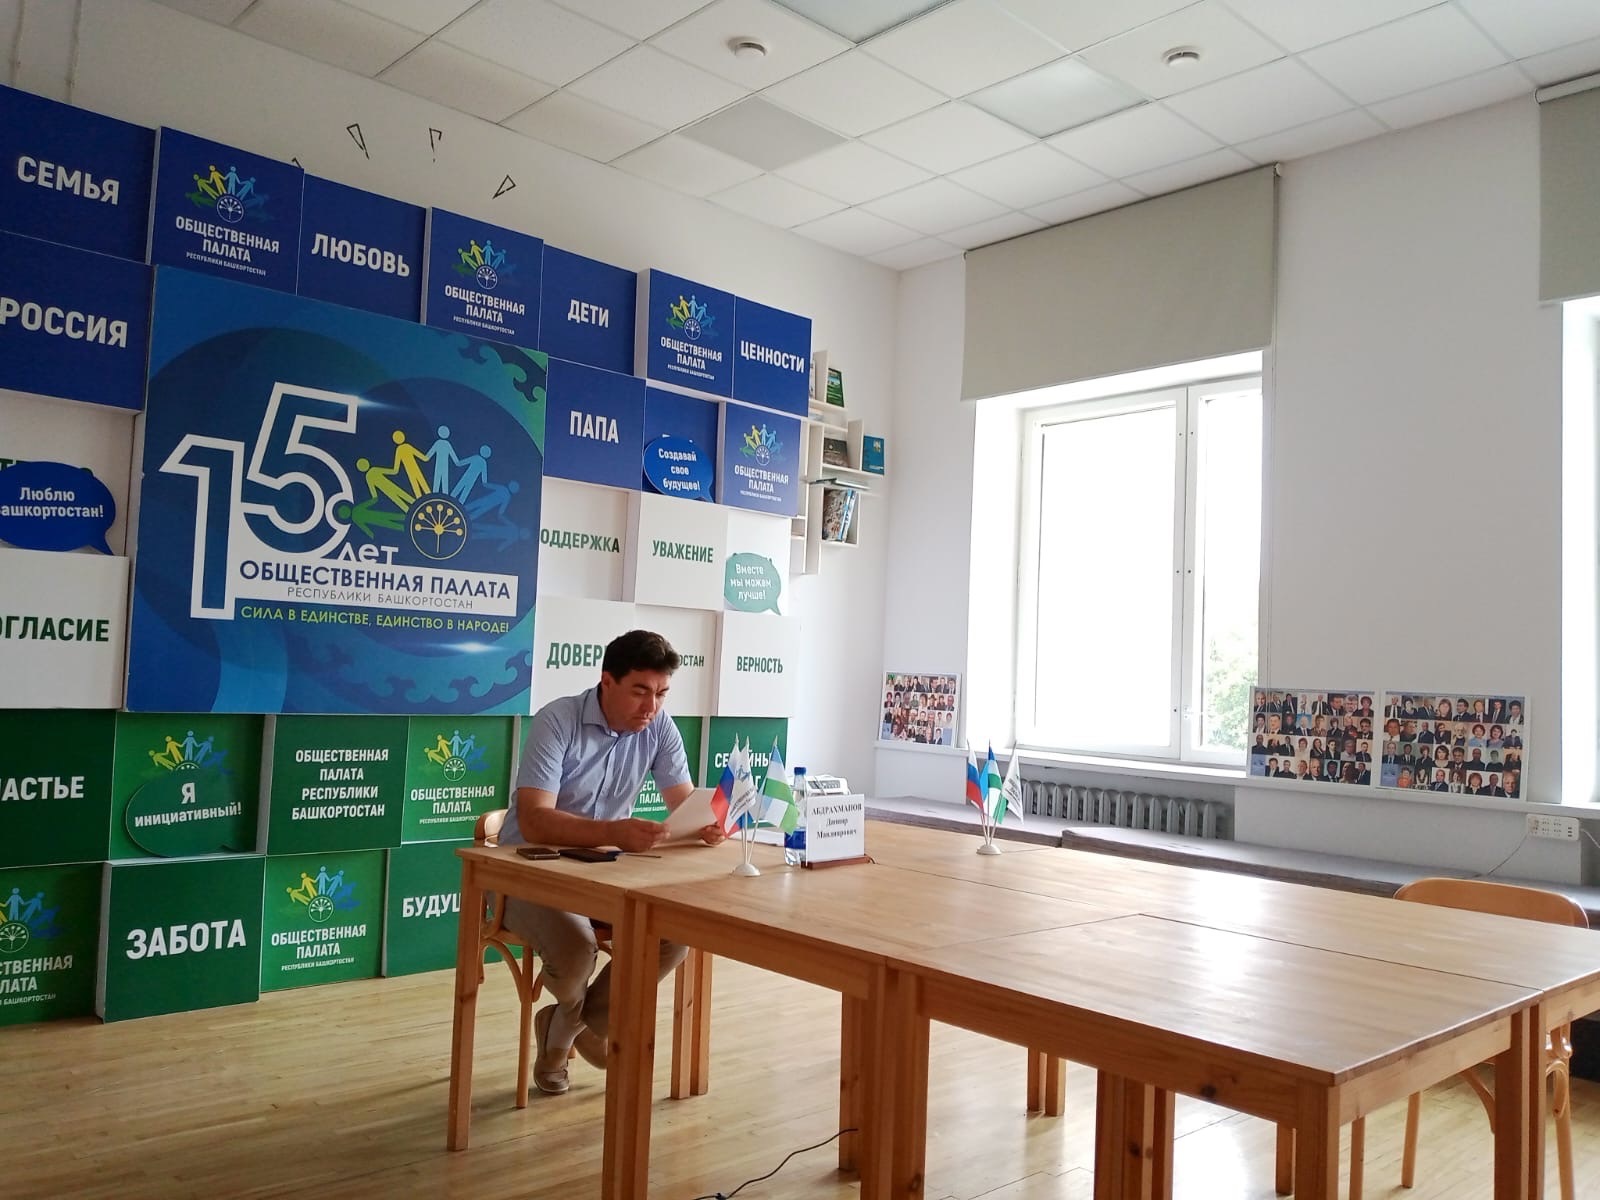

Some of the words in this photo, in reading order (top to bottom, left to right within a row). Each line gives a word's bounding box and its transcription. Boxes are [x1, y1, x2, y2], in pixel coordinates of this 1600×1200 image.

[17, 155, 120, 205] СЕМЬЯ
[175, 215, 280, 254] ОБЩЕСТВЕННАЯ
[202, 238, 251, 263] ПАЛАТА
[311, 233, 410, 278] ЛЮБОВЬ
[444, 284, 525, 316] ОБЩЕСТВЕННАЯ
[0, 297, 128, 348] РОССИЯ
[465, 304, 503, 324] ПАЛАТА
[567, 299, 609, 329] ДЕТИ
[660, 336, 723, 363] ОБЩЕСТВЕННАЯ
[740, 340, 805, 373] ЦЕННОСТИ
[677, 353, 706, 370] ПАЛАТА
[569, 411, 619, 444] ПАПА
[658, 447, 697, 462] Создавай
[663, 477, 701, 491] будущее!
[734, 464, 789, 486] ОБЩЕСТВЕННАЯ
[748, 479, 775, 493] ПАЛАТА
[20, 487, 76, 502] Люблю
[0, 503, 104, 520] ашкортостан!
[540, 527, 621, 554] ОДДЕРЖКА
[652, 540, 714, 563] УВАЖЕНИЕ
[337, 541, 399, 566] лет
[240, 560, 423, 593] ОБЩЕСТВЕННАЯ
[431, 576, 511, 600] ПАЛАТА
[735, 563, 764, 575] Вместе
[730, 578, 743, 588] мы
[744, 578, 772, 588] можем
[287, 586, 371, 602] РЕСПУБЛИКИ
[377, 593, 473, 609] БАШКОРТОСТАН
[738, 590, 766, 602] лучше!
[0, 615, 110, 642] ГЛАСИЕ
[241, 605, 284, 620] СИЛА
[288, 608, 296, 621] В
[300, 609, 373, 627] ЕДИНСТВЕ,
[376, 614, 444, 630] ЕДИНСТВО
[447, 618, 454, 630] В
[457, 619, 510, 634] НАРОДЕ!
[546, 642, 607, 669] ДОВЕР
[736, 656, 783, 674] ВЕРНОСТЬ
[295, 748, 389, 764] ОБЩЕСТВЕННАЯ
[319, 767, 365, 782] ПАЛАТА
[0, 776, 85, 802] АСТЬЕ
[181, 782, 196, 805] Я
[302, 785, 379, 801] РЕСПУБЛИКИ
[410, 785, 495, 801] ОБЩЕСТВЕННАЯ
[640, 792, 664, 804] ПАЛА
[134, 802, 242, 828] инициативный!
[292, 804, 385, 821] БАШКОРТОСТАН
[432, 800, 472, 815] ПАЛАТА
[125, 919, 247, 960] ЗАБОТА
[271, 924, 367, 946] ОБЩЕСТВЕННАЯ
[296, 942, 341, 960] ПАЛАТА
